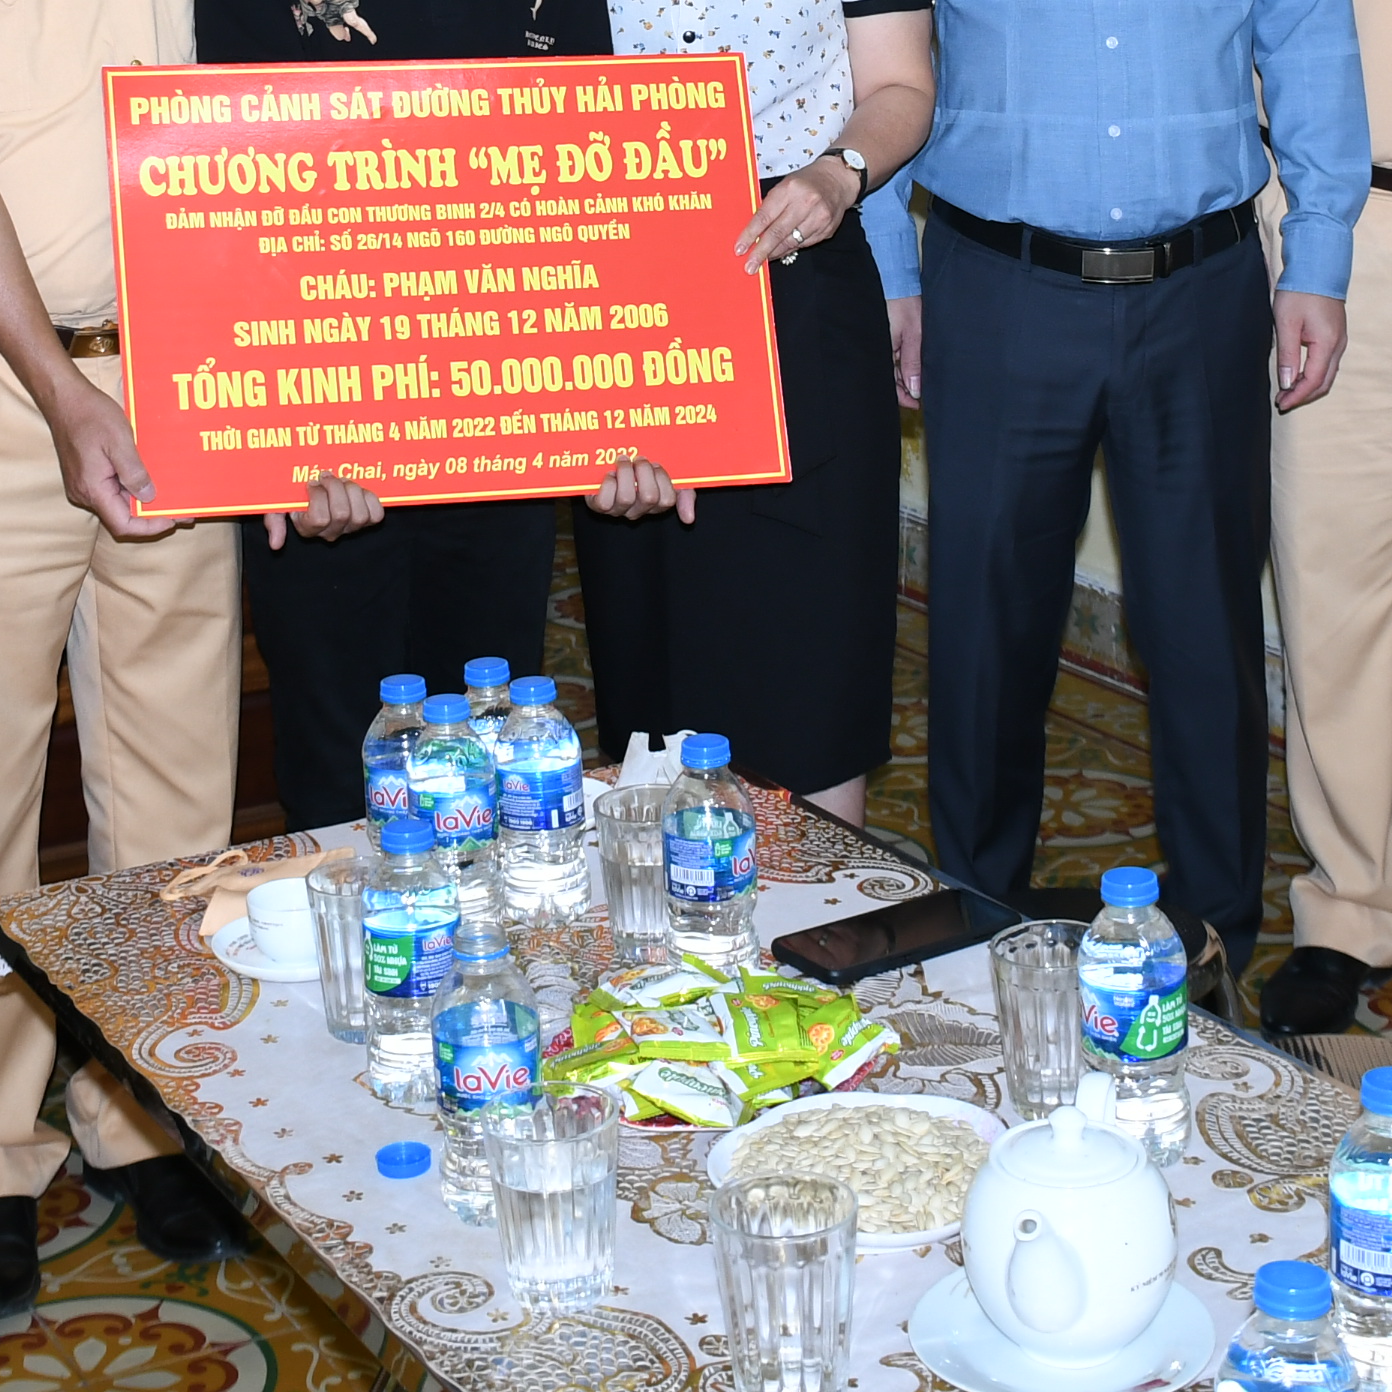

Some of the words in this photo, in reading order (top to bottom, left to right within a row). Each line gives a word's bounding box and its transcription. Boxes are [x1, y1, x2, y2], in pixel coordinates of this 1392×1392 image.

[130, 89, 231, 125] PHÒNG
[241, 85, 321, 121] CẢNH
[329, 86, 383, 119] SÁT
[391, 83, 490, 118] ĐƯỜNG
[497, 78, 567, 115] THỦY
[576, 76, 623, 113] HẢI
[631, 76, 725, 111] PHÒNG
[139, 147, 317, 196] CHƯƠNG
[327, 139, 458, 191] TRÌNH
[556, 131, 612, 183] ĐỠ
[165, 208, 205, 229] ĐẢM
[210, 209, 257, 230] NHẬN
[261, 206, 285, 226] ĐỠ
[327, 207, 363, 224] CON
[366, 205, 431, 222] THƯƠNG
[436, 203, 475, 220] BINH
[480, 202, 505, 218] 2/4
[510, 198, 532, 217] CÓ
[536, 196, 580, 215] HOÀN
[584, 193, 628, 213] CẢNH
[632, 193, 664, 212] KHÓ
[668, 191, 712, 210] KHĂN
[259, 237, 288, 256] ĐỊA
[292, 230, 325, 252] CHỈ:
[330, 229, 353, 251] SỐ
[357, 233, 403, 250] 26/14
[407, 228, 441, 248] NGÕ
[446, 230, 475, 247] 160
[479, 224, 535, 245] ĐƯỜNG
[540, 222, 573, 243] NGÔ
[300, 269, 376, 300] CHÁU:
[383, 270, 458, 301] PHẠM
[464, 263, 515, 294] VĂN
[522, 260, 599, 291] NGHĨA
[233, 320, 296, 347] SINH
[303, 312, 371, 344] NGÀY
[380, 315, 410, 341] 19
[417, 307, 500, 338] THÁNG
[507, 309, 538, 334] 12
[544, 302, 602, 332] NĂM
[610, 303, 669, 329] 2006
[172, 357, 267, 410] TỔNG
[277, 365, 362, 405] KINH
[372, 355, 441, 400] PHÍ:
[450, 352, 634, 397] 50.000.000
[642, 337, 734, 386] ĐỒNG
[200, 425, 242, 451] THỜI
[247, 427, 292, 449] GIAN
[296, 422, 320, 445] TỪ
[324, 420, 384, 444] THÁNG
[389, 422, 400, 441] 4
[405, 417, 447, 440] NĂM
[452, 417, 496, 438] 2022
[500, 409, 536, 435] ĐẾN
[540, 409, 599, 432] THÁNG
[604, 410, 624, 429] 12
[630, 404, 670, 427] NĂM
[675, 404, 717, 424] 2024
[292, 464, 333, 483] Má
[338, 461, 386, 480] Chai,
[393, 458, 440, 481] ngày
[445, 457, 468, 474] 08
[473, 454, 526, 474] tháng
[532, 453, 543, 468] 4
[549, 451, 589, 469] năm
